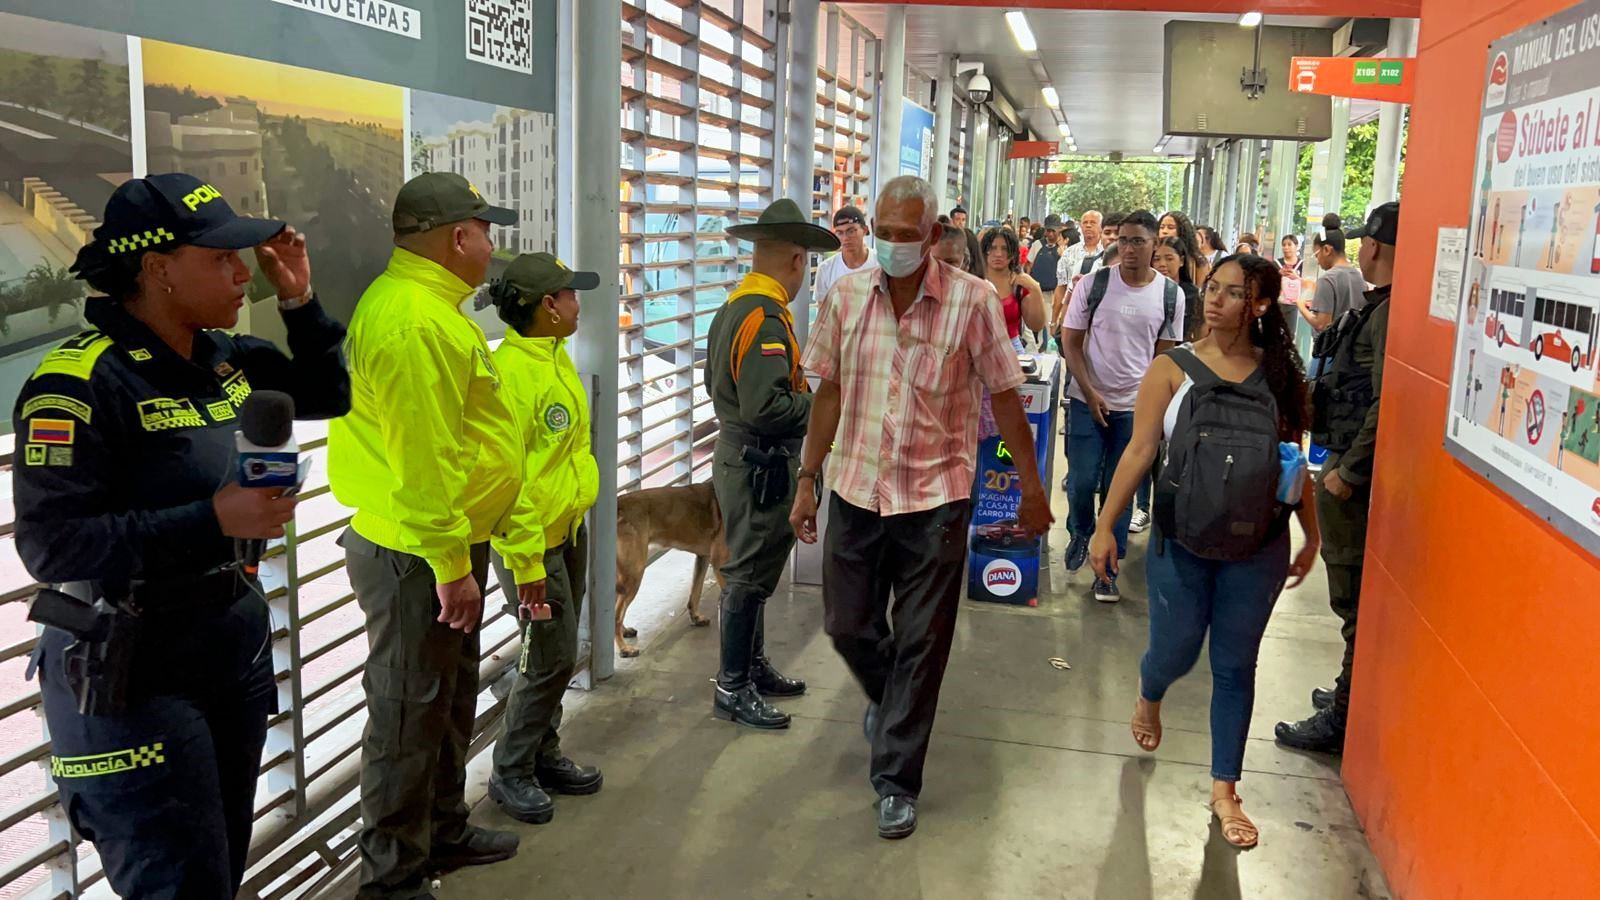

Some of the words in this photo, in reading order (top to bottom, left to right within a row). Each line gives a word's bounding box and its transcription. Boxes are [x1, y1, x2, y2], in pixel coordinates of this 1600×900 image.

[346, 0, 399, 30] ETAPA
[402, 11, 410, 32] 5
[1512, 32, 1553, 76] MANUAL
[1555, 23, 1577, 60] DEL
[1355, 67, 1376, 77] X105
[1380, 69, 1400, 77] X102
[1519, 107, 1570, 158] Súbete
[1573, 97, 1593, 150] al
[1513, 163, 1527, 188] del
[1527, 163, 1546, 187] buen
[1547, 164, 1563, 185] uso
[1564, 157, 1581, 184] del
[979, 493, 1014, 503] IMAGINA
[986, 501, 1008, 510] CASA
[978, 509, 1004, 518] CARRO
[989, 572, 1016, 582] DIANA
[66, 757, 128, 774] POLICÍA
